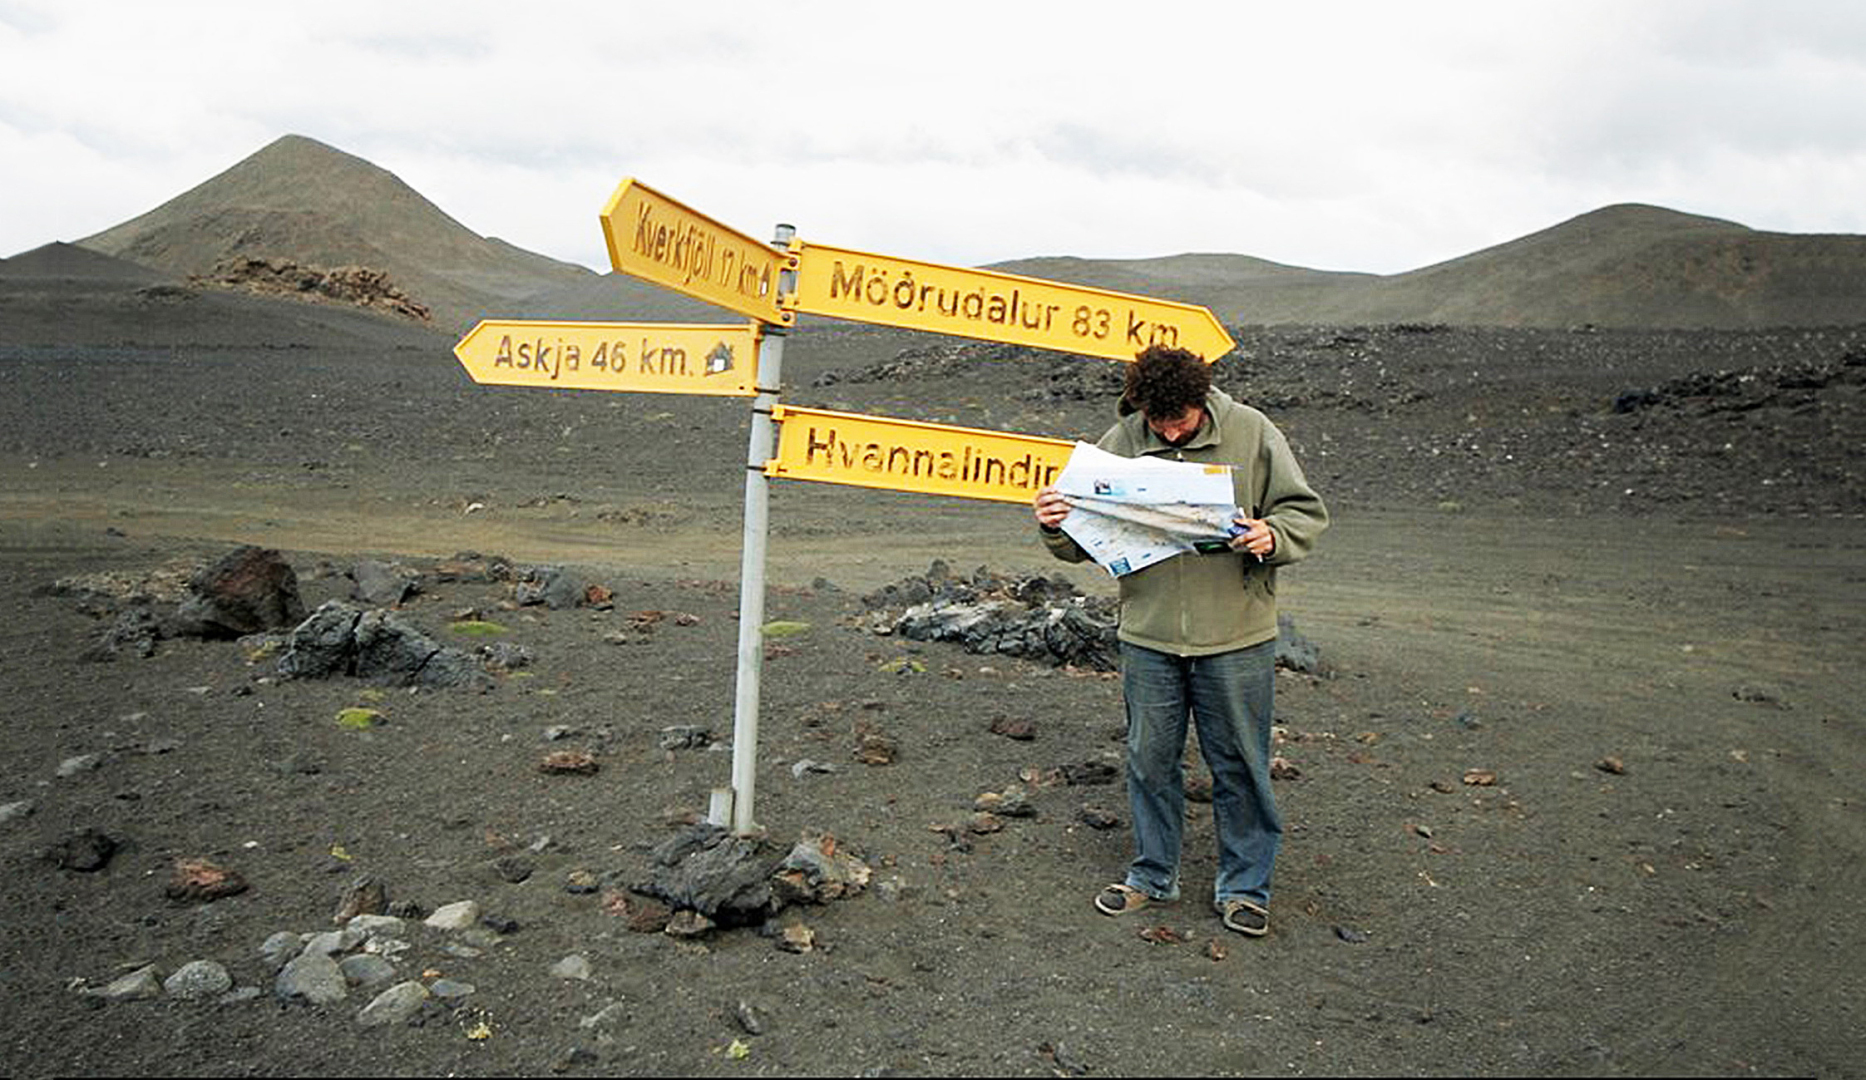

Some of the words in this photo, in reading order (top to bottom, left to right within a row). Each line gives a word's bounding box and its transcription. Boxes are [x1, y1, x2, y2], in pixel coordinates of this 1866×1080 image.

[633, 200, 715, 286] Kverkfjöll
[720, 246, 735, 287] 17
[738, 250, 758, 295] km
[830, 260, 1060, 333] Möðrudalur
[1072, 304, 1112, 340] 83
[1126, 310, 1180, 347] km
[494, 334, 581, 380] Askja
[591, 341, 627, 373] 46
[640, 338, 695, 377] km.
[805, 426, 1059, 489] Hvannalindir
